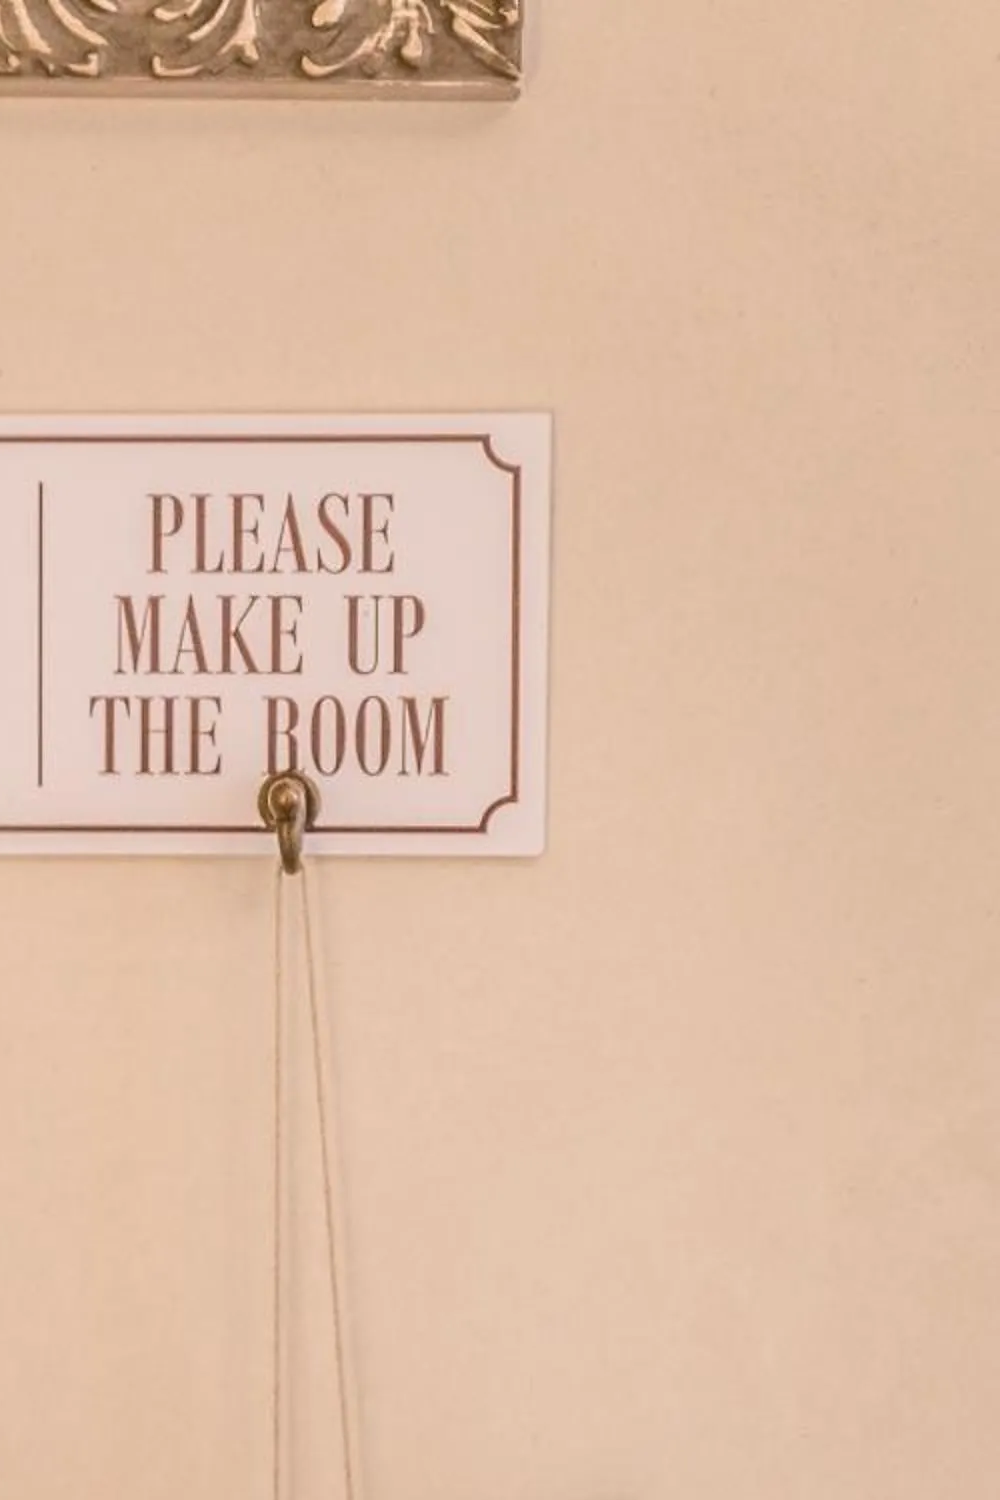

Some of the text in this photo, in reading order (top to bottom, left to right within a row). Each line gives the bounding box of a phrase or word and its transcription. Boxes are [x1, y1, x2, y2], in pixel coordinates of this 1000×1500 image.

[147, 493, 396, 575] PLEASE
[113, 594, 426, 675] MAKE UP
[89, 695, 449, 777] THE ROOM
